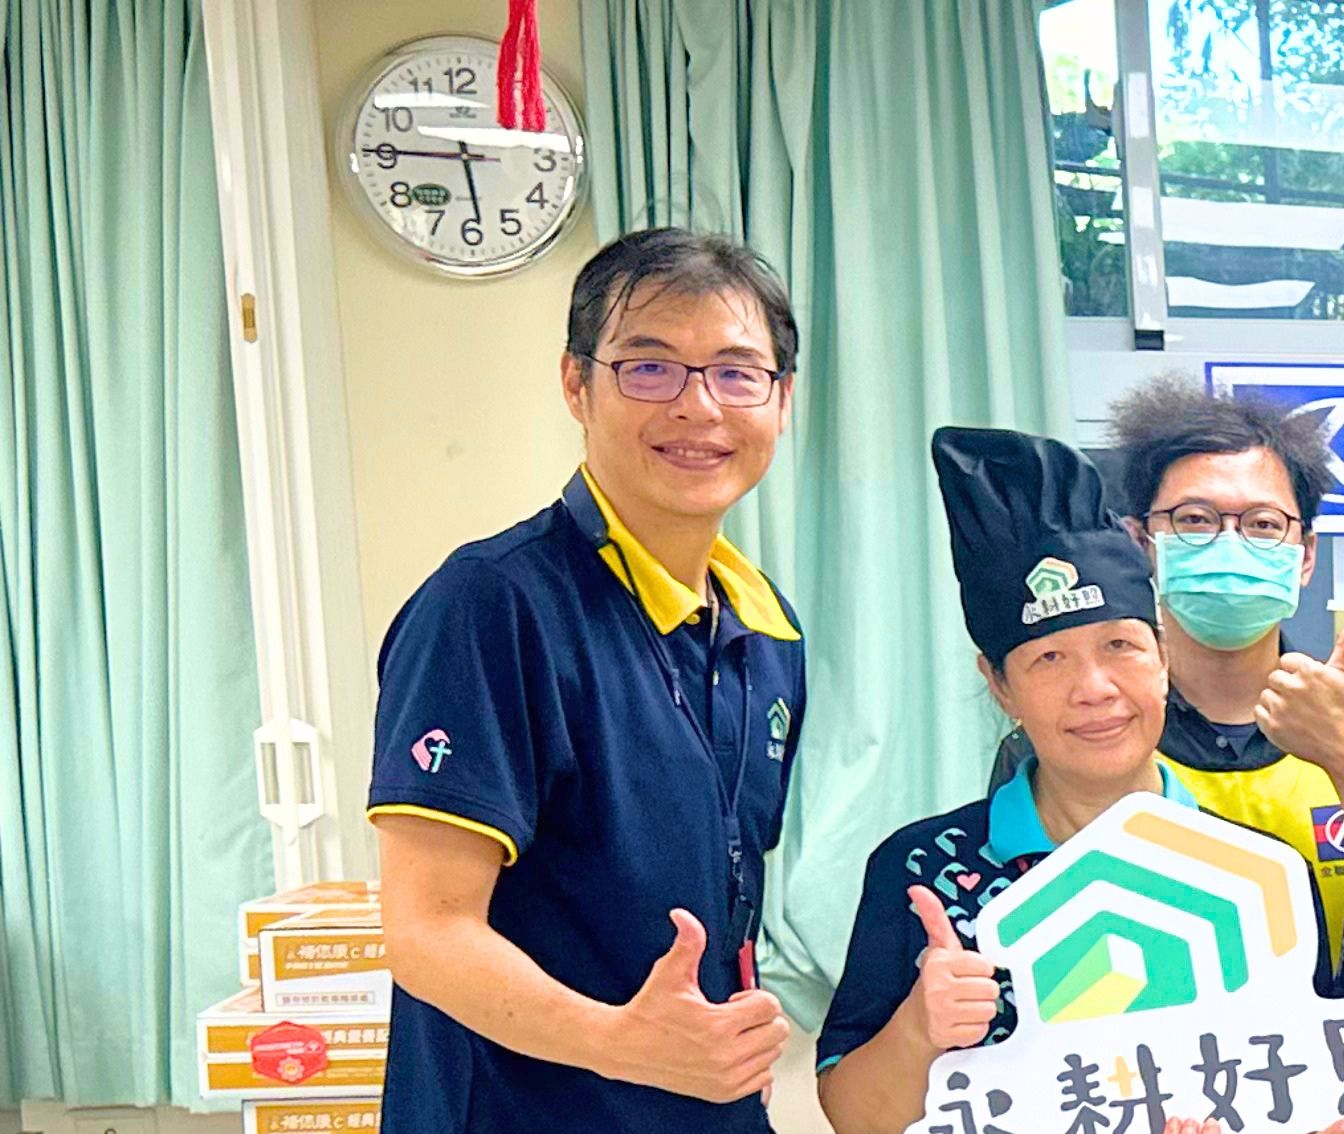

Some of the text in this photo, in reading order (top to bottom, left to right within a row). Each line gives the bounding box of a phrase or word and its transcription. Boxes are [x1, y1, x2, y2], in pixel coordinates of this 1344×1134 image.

[443, 67, 477, 95] 12
[376, 143, 398, 169] 9
[390, 181, 412, 208] 8
[525, 183, 550, 209] 4
[425, 210, 446, 236] 7
[461, 218, 483, 246] 6
[500, 209, 522, 236] 5
